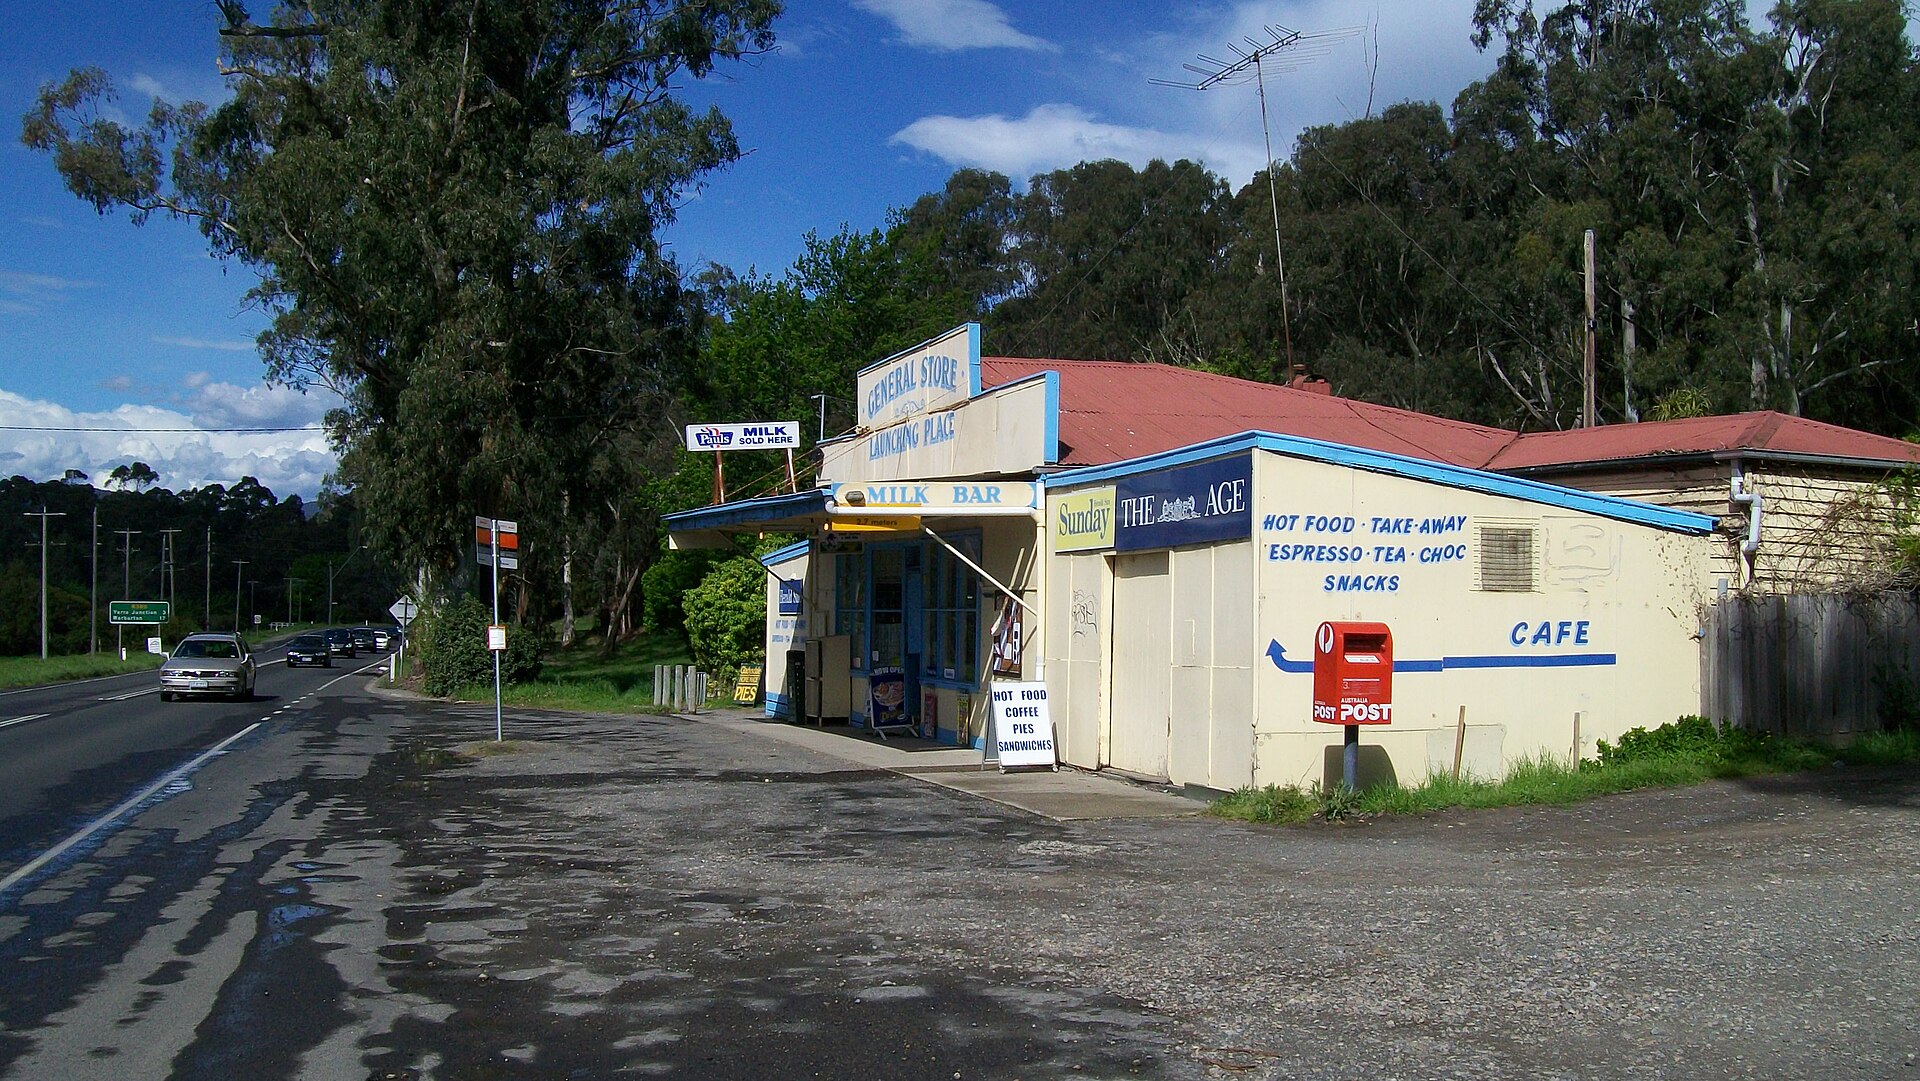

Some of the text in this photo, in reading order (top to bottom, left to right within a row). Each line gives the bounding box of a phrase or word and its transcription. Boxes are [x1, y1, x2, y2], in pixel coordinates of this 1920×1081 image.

[868, 355, 958, 419] GENERAL STORE
[700, 433, 730, 444] Pauls
[743, 426, 787, 436] MILK
[869, 411, 955, 461] LAUNCHING PLACE
[739, 437, 764, 445] SOLD
[866, 485, 1002, 504] MILK BAR
[1121, 479, 1246, 528] THE AGE
[1059, 499, 1111, 540] Sunday
[1263, 514, 1300, 531] HOT
[1305, 515, 1356, 533] FOOD
[1269, 544, 1467, 563] ESPRESSO TEA CHOC
[1323, 575, 1400, 592] SNACKS
[1510, 621, 1590, 646] CAFE
[734, 686, 758, 701] PIES
[994, 690, 1047, 701] HOT FOOD
[1005, 707, 1039, 717] COFFEE
[1314, 705, 1336, 719] POST
[1340, 704, 1391, 721] POST
[1013, 724, 1034, 734] PIES
[998, 740, 1052, 751] SANDWICHES
